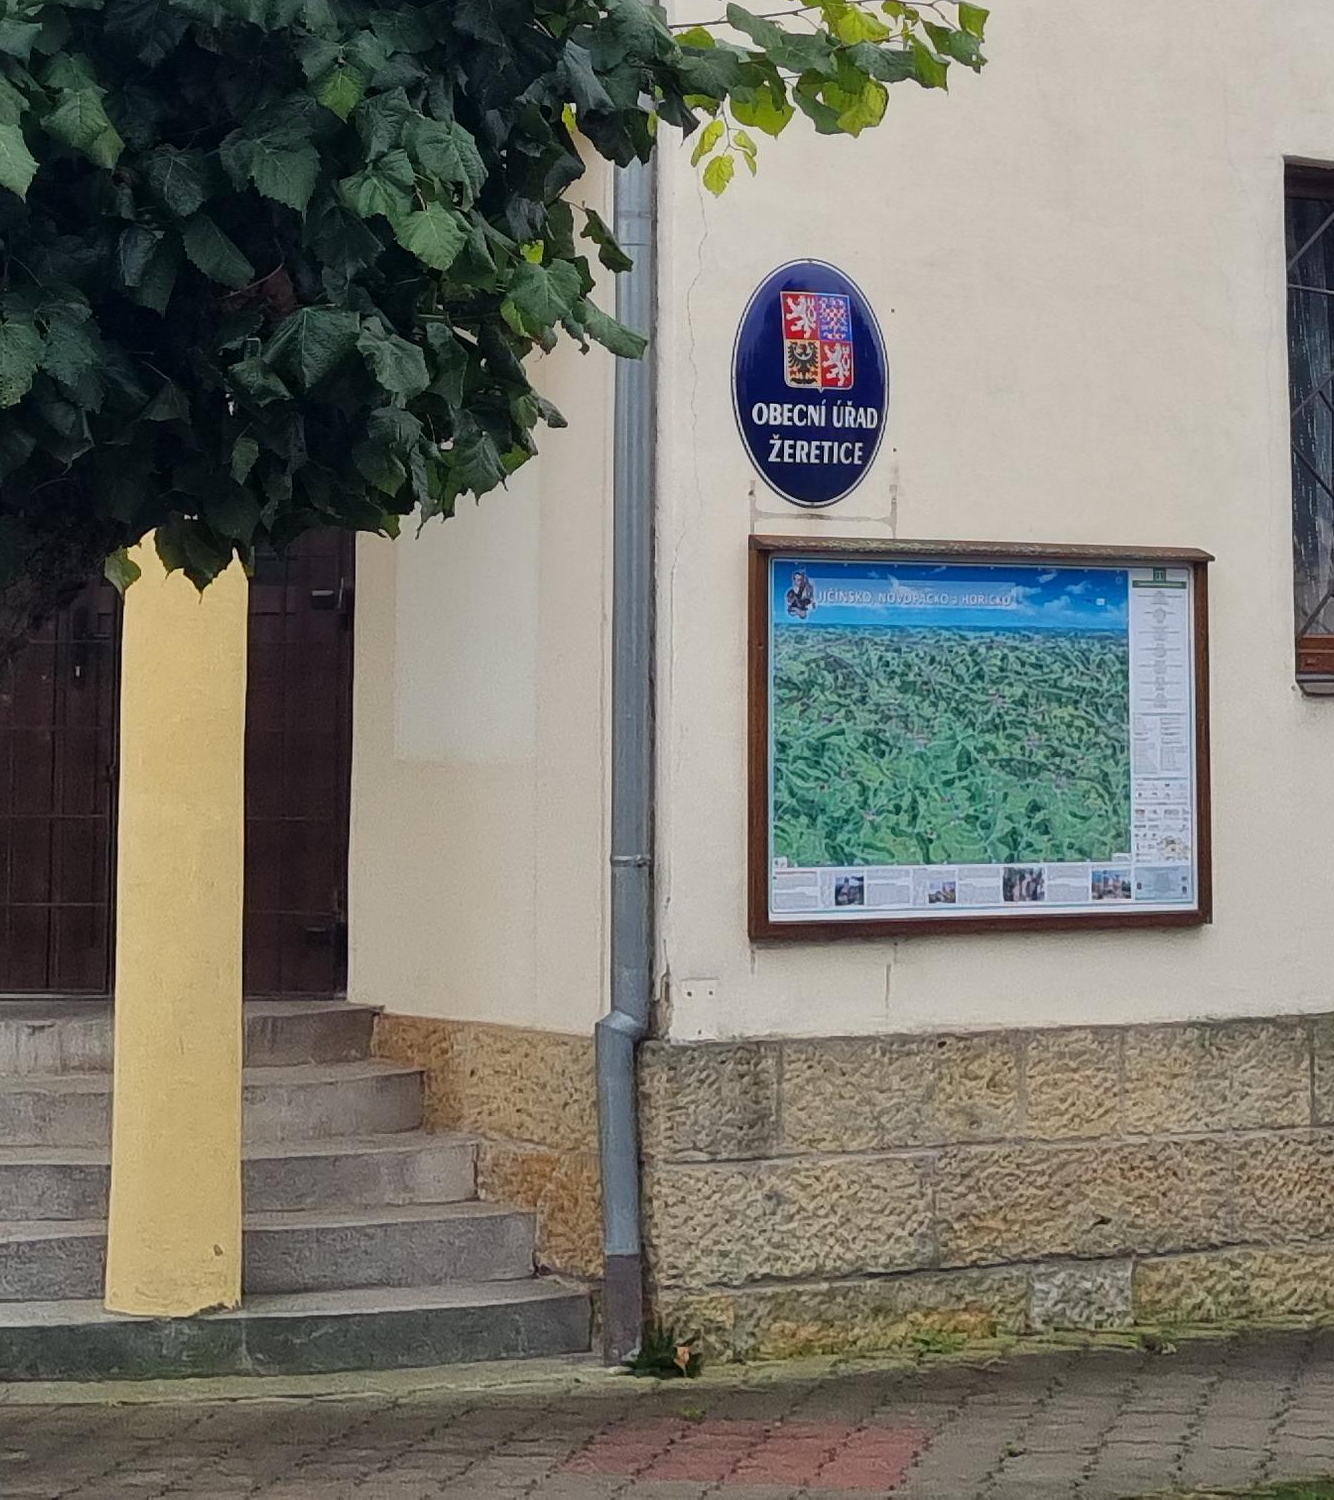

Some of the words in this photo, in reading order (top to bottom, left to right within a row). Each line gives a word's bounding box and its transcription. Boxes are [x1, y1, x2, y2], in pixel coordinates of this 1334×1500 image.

[751, 399, 827, 427] OBECNÍ
[832, 400, 878, 429] ÚŘAD
[768, 433, 863, 464] ŽERETICE
